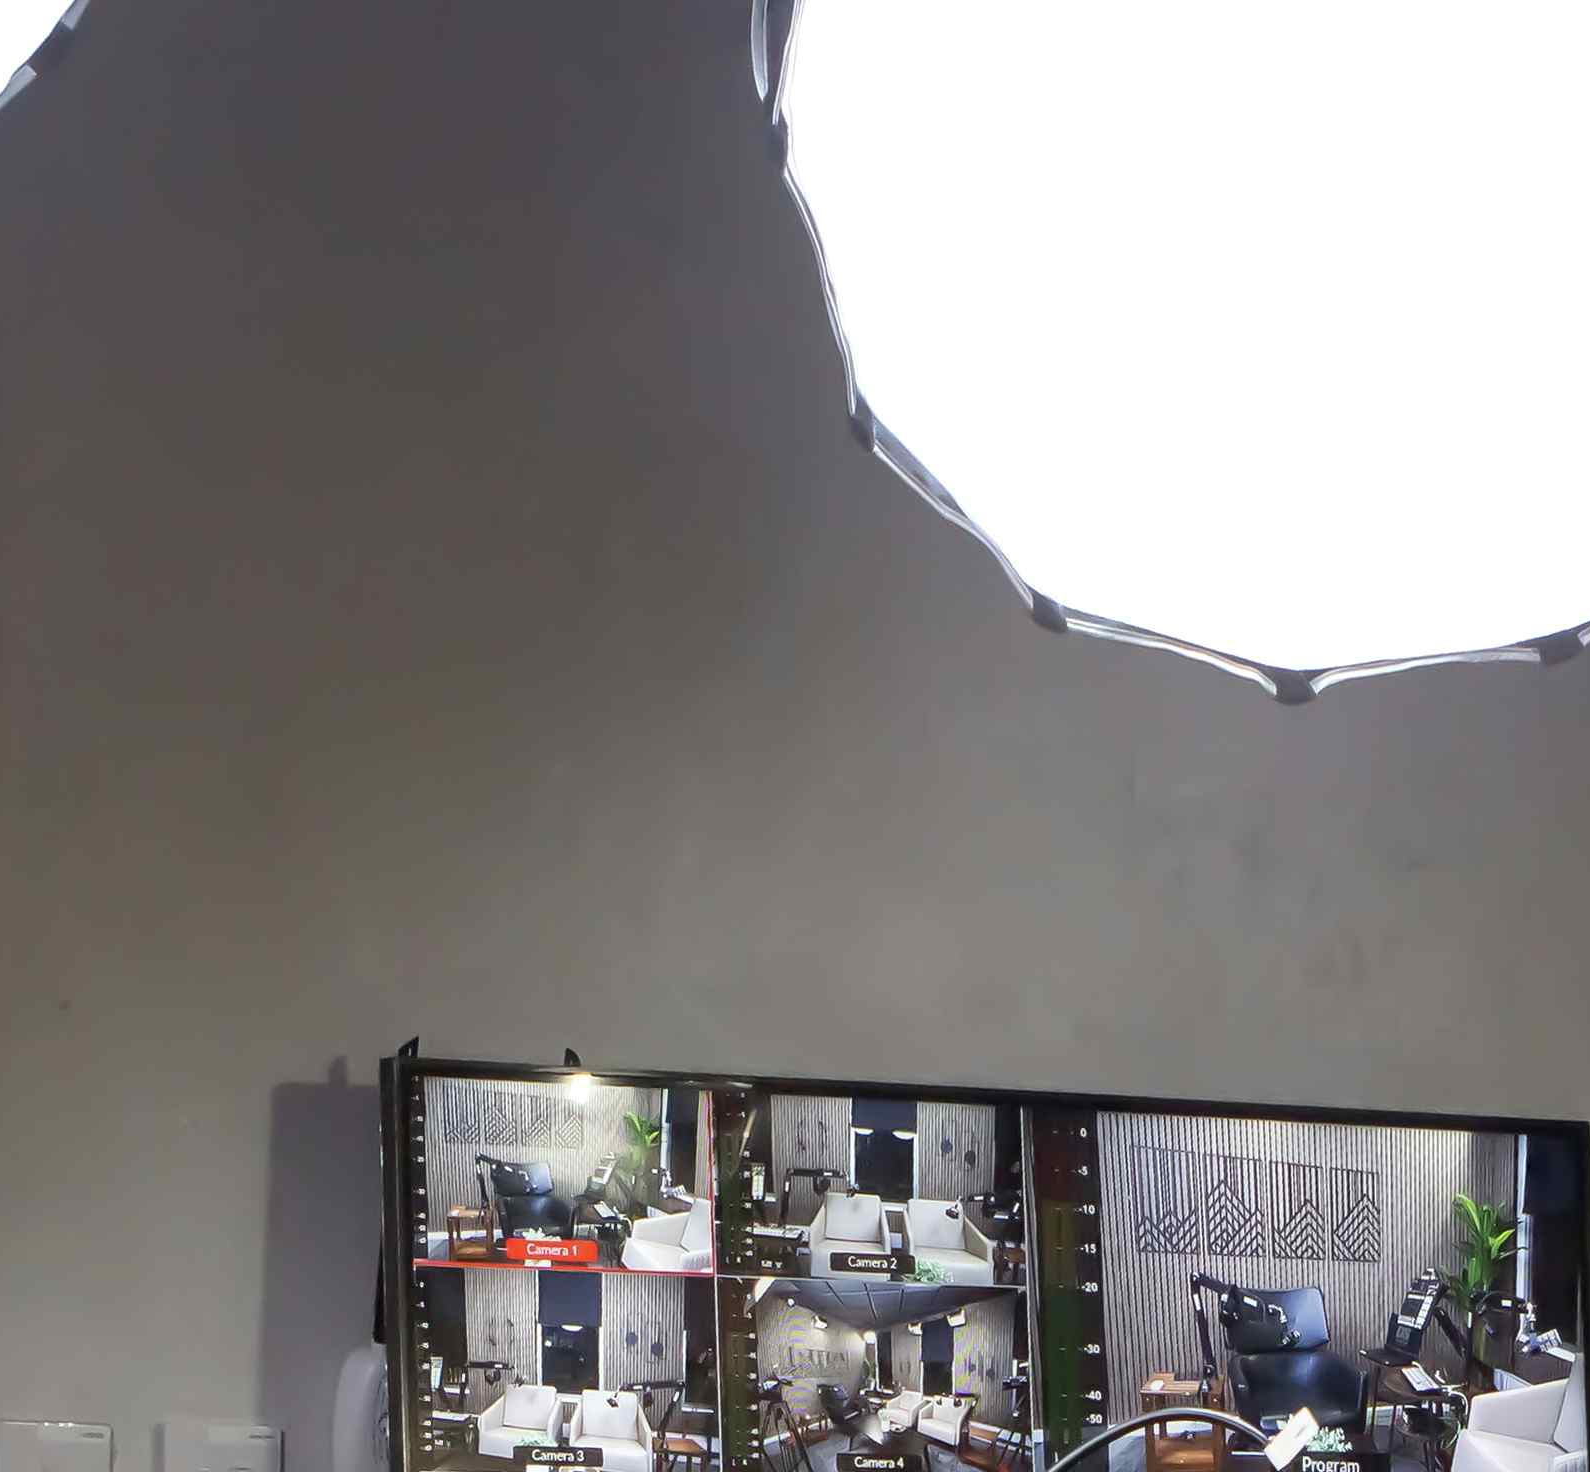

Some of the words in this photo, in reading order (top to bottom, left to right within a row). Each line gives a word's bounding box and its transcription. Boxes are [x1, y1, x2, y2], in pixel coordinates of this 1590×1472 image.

[1079, 1204, 1096, 1214] -10
[527, 1243, 569, 1256] Camera
[572, 1245, 578, 1256] 1
[1080, 1243, 1097, 1254] -15
[848, 1256, 888, 1268] Camera
[890, 1257, 897, 1269] 2
[1081, 1282, 1098, 1292] -20
[1084, 1344, 1100, 1354] -30
[1085, 1390, 1101, 1400] -40
[1086, 1414, 1102, 1424] -50
[532, 1449, 574, 1462] Camera
[576, 1450, 585, 1461] 3
[854, 1456, 895, 1469] Camera
[897, 1457, 904, 1469] 4
